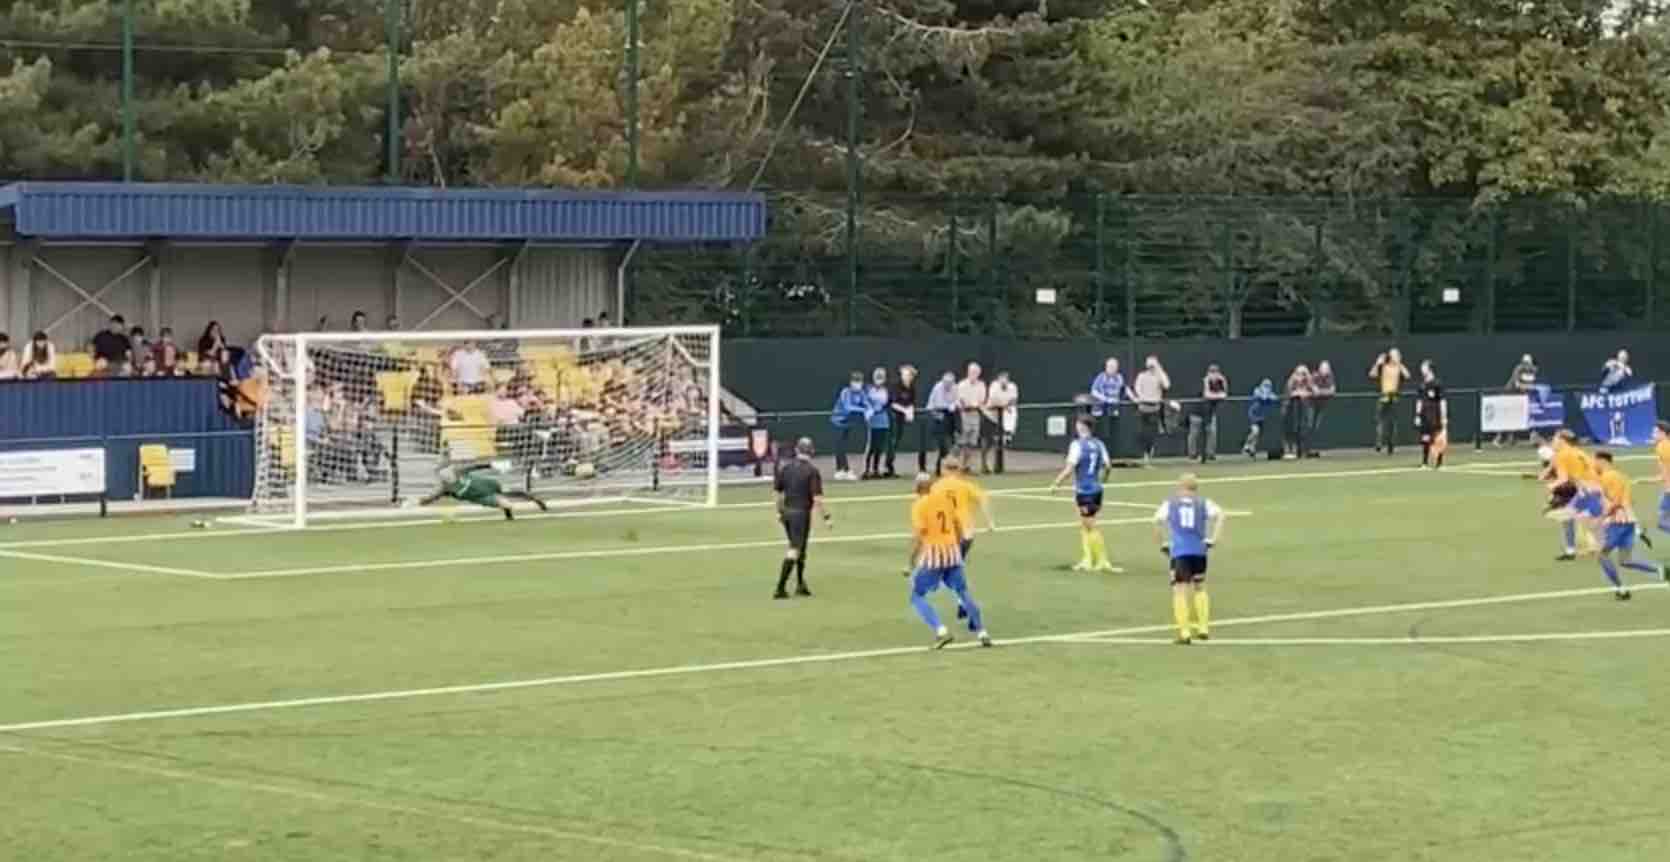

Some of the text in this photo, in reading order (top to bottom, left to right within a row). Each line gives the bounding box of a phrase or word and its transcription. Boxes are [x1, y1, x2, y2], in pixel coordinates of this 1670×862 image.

[1580, 393, 1605, 409] AFC
[936, 511, 951, 535] 2
[1179, 506, 1195, 528] 11
